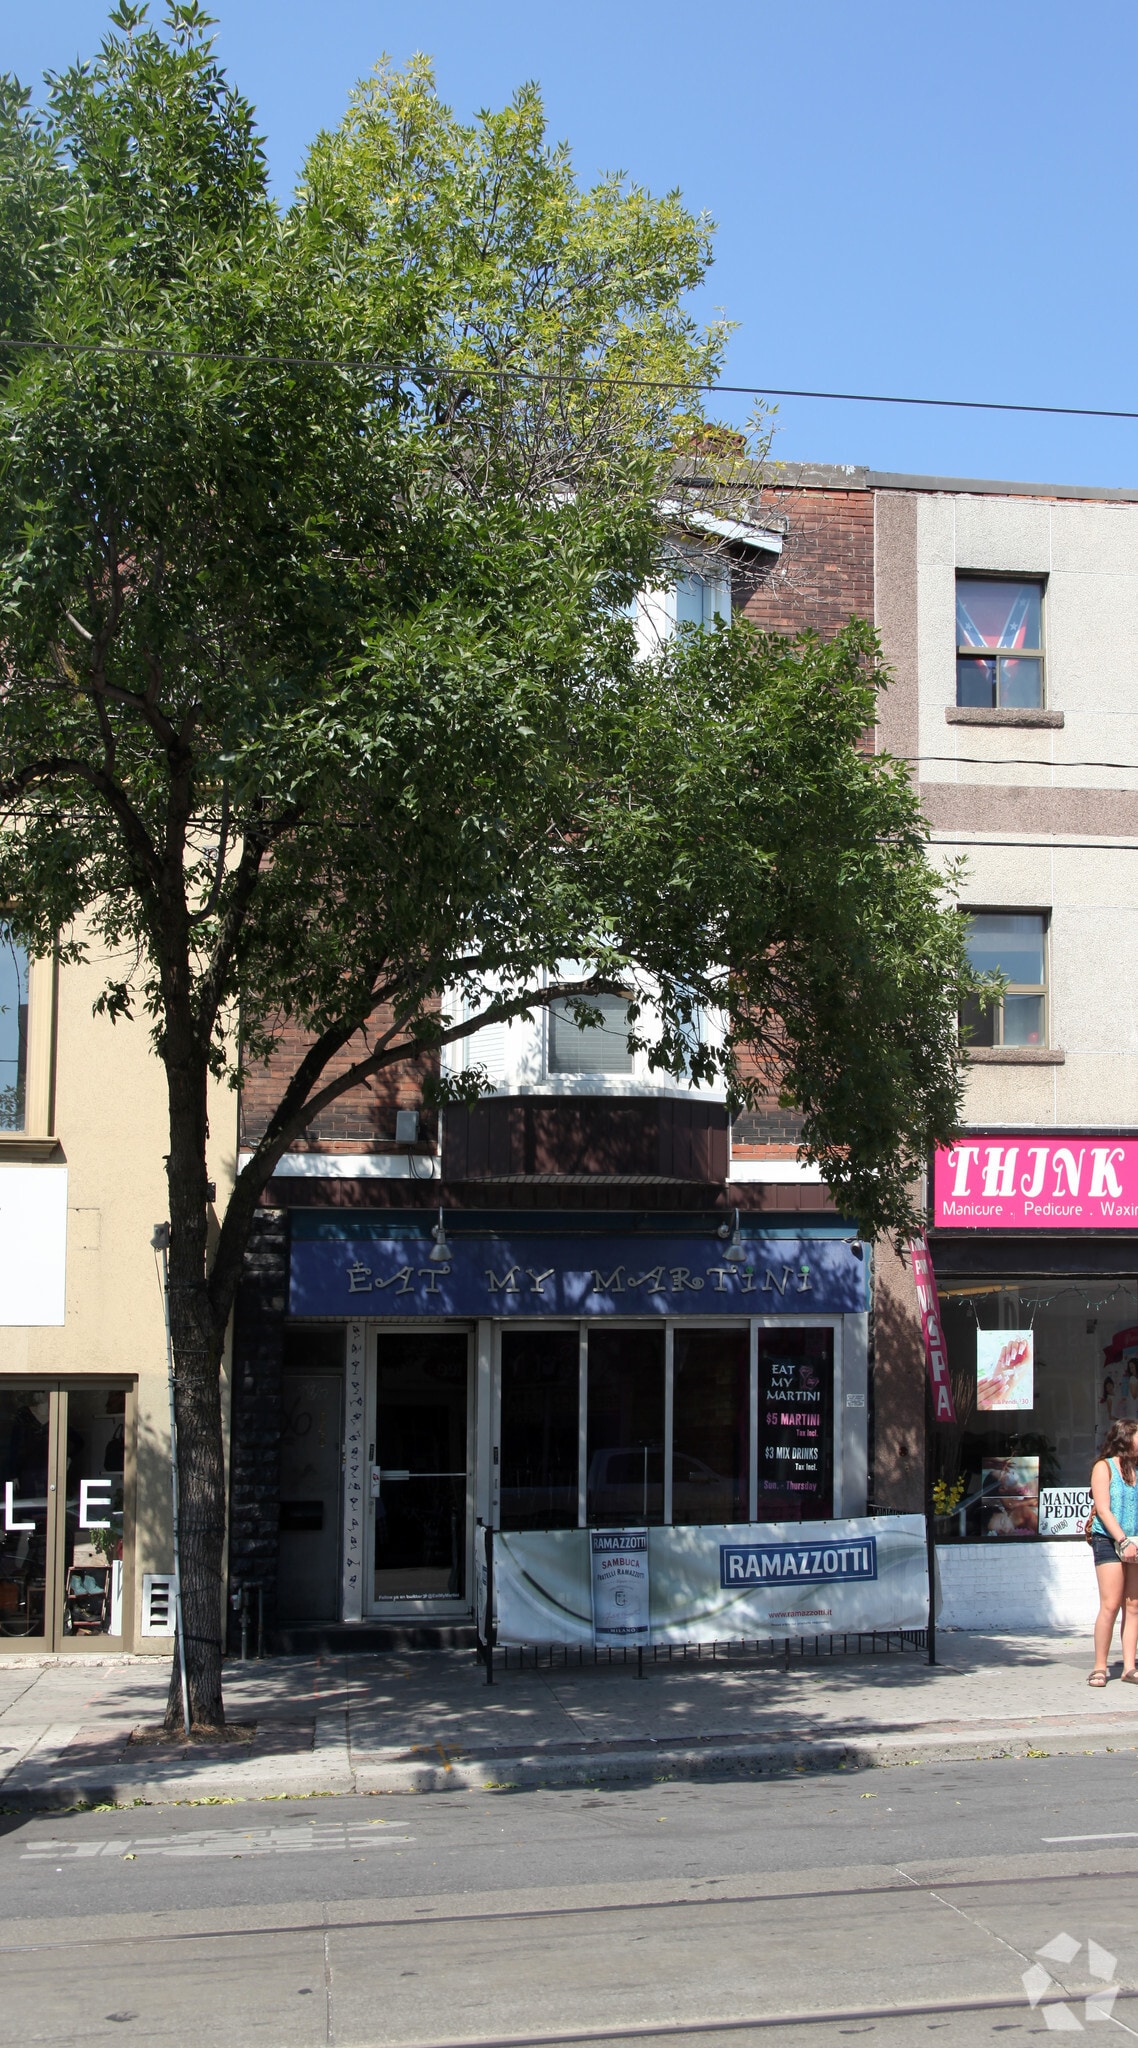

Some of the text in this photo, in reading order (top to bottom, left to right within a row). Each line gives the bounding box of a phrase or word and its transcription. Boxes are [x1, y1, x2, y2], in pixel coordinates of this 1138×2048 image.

[943, 1201, 1003, 1216] Manicure
[1024, 1201, 1083, 1216] Pedicure
[347, 1261, 451, 1295] EAT
[485, 1265, 555, 1293] MY
[772, 1365, 795, 1375] EAT
[771, 1378, 792, 1388] MY
[766, 1390, 820, 1402] MARTINI
[766, 1412, 820, 1426] $5 MARTINI
[796, 1429, 806, 1437] Tax
[776, 1447, 790, 1459] MIX
[792, 1447, 818, 1460] DRINKS
[795, 1463, 804, 1471] Tax
[786, 1481, 817, 1492] Thursday
[1044, 1505, 1094, 1518] PEDIC
[593, 1536, 646, 1550] RAMAZZOTTI
[601, 1557, 640, 1570] SAMBUCA
[729, 1547, 869, 1579] RAMAZZOTTI
[768, 1609, 832, 1618] www.ramazzotti.it
